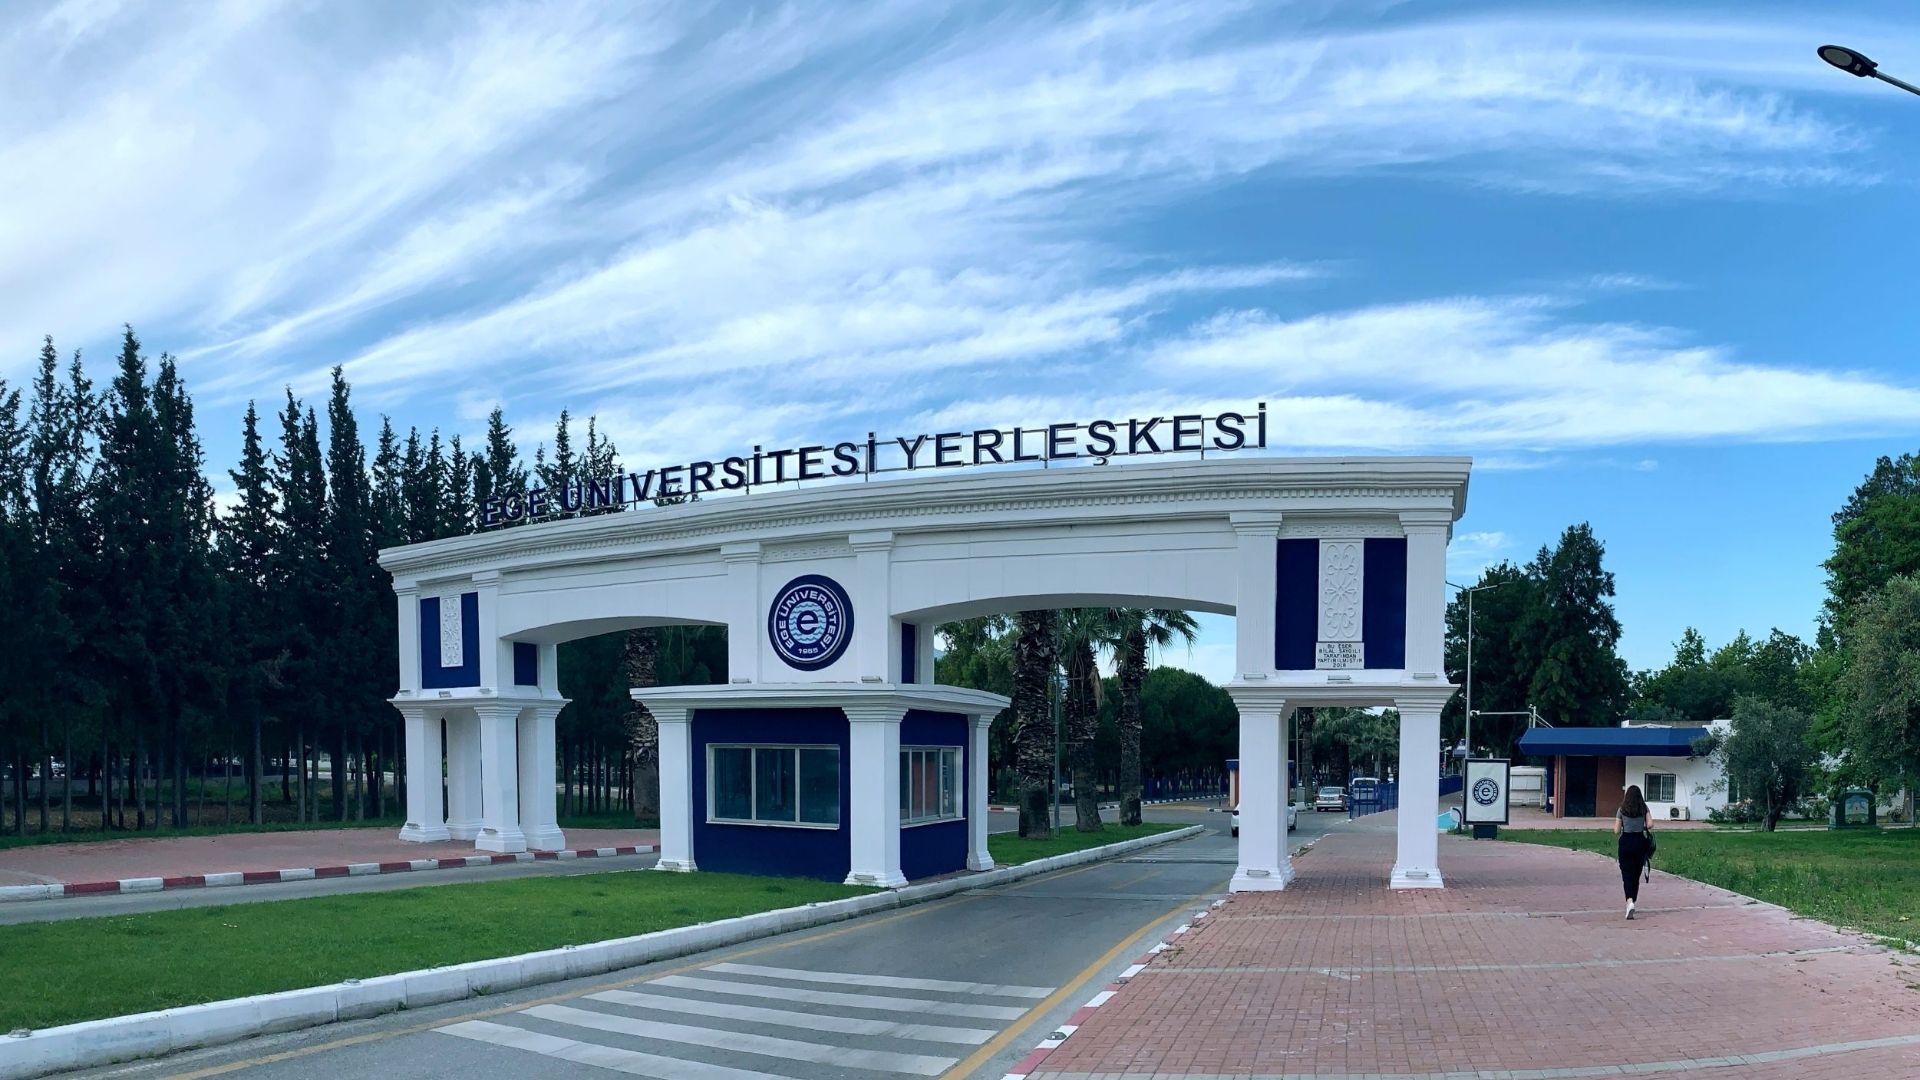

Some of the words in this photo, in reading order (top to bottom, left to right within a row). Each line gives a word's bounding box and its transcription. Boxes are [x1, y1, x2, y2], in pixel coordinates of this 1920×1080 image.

[482, 487, 548, 526] EGE
[896, 402, 1267, 466] YERLEŞKESİ
[779, 620, 795, 649] EGE
